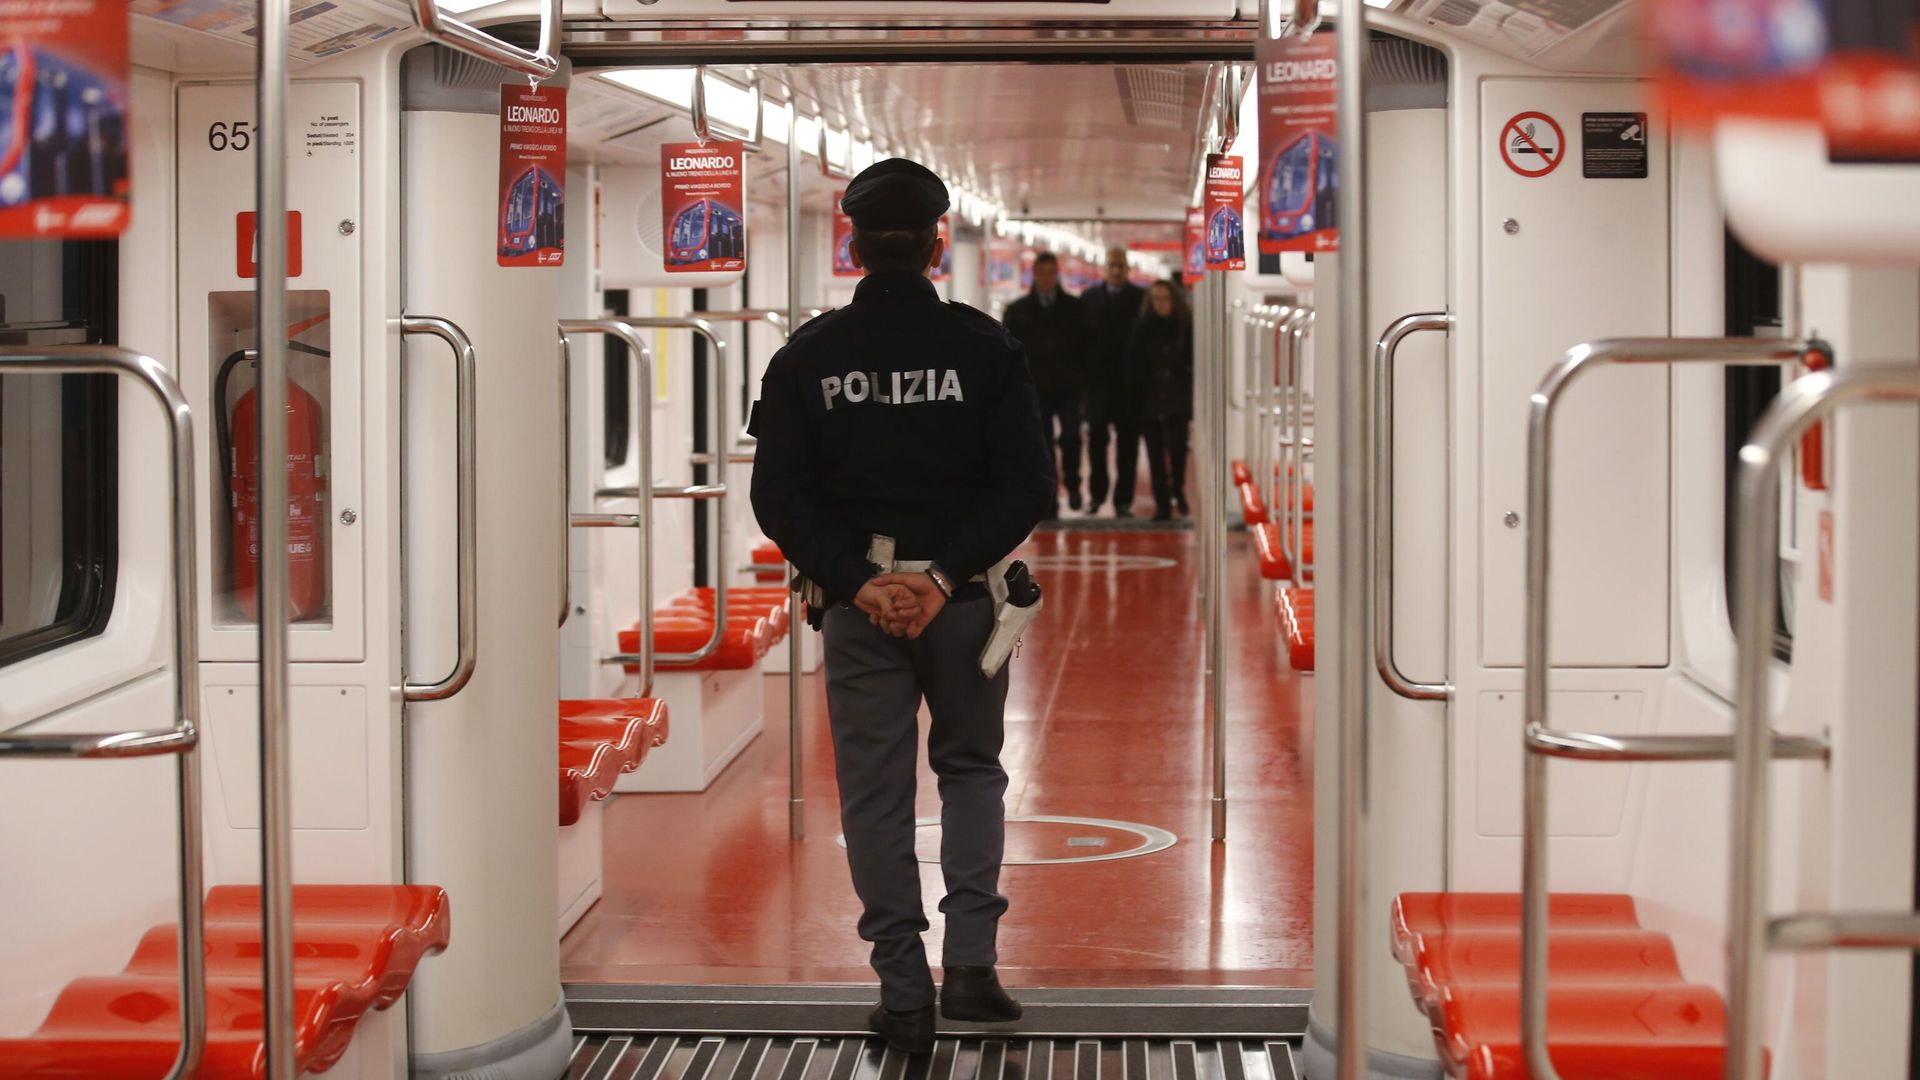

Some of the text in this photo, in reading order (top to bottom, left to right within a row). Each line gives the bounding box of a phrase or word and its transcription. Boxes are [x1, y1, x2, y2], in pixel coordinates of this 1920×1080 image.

[1265, 59, 1337, 83] LEONARD
[507, 105, 560, 124] LEONARDO
[208, 121, 258, 151] 65
[670, 156, 734, 170] LEONARDO
[1209, 167, 1240, 179] LEONARDO
[821, 369, 964, 411] POLIZIA
